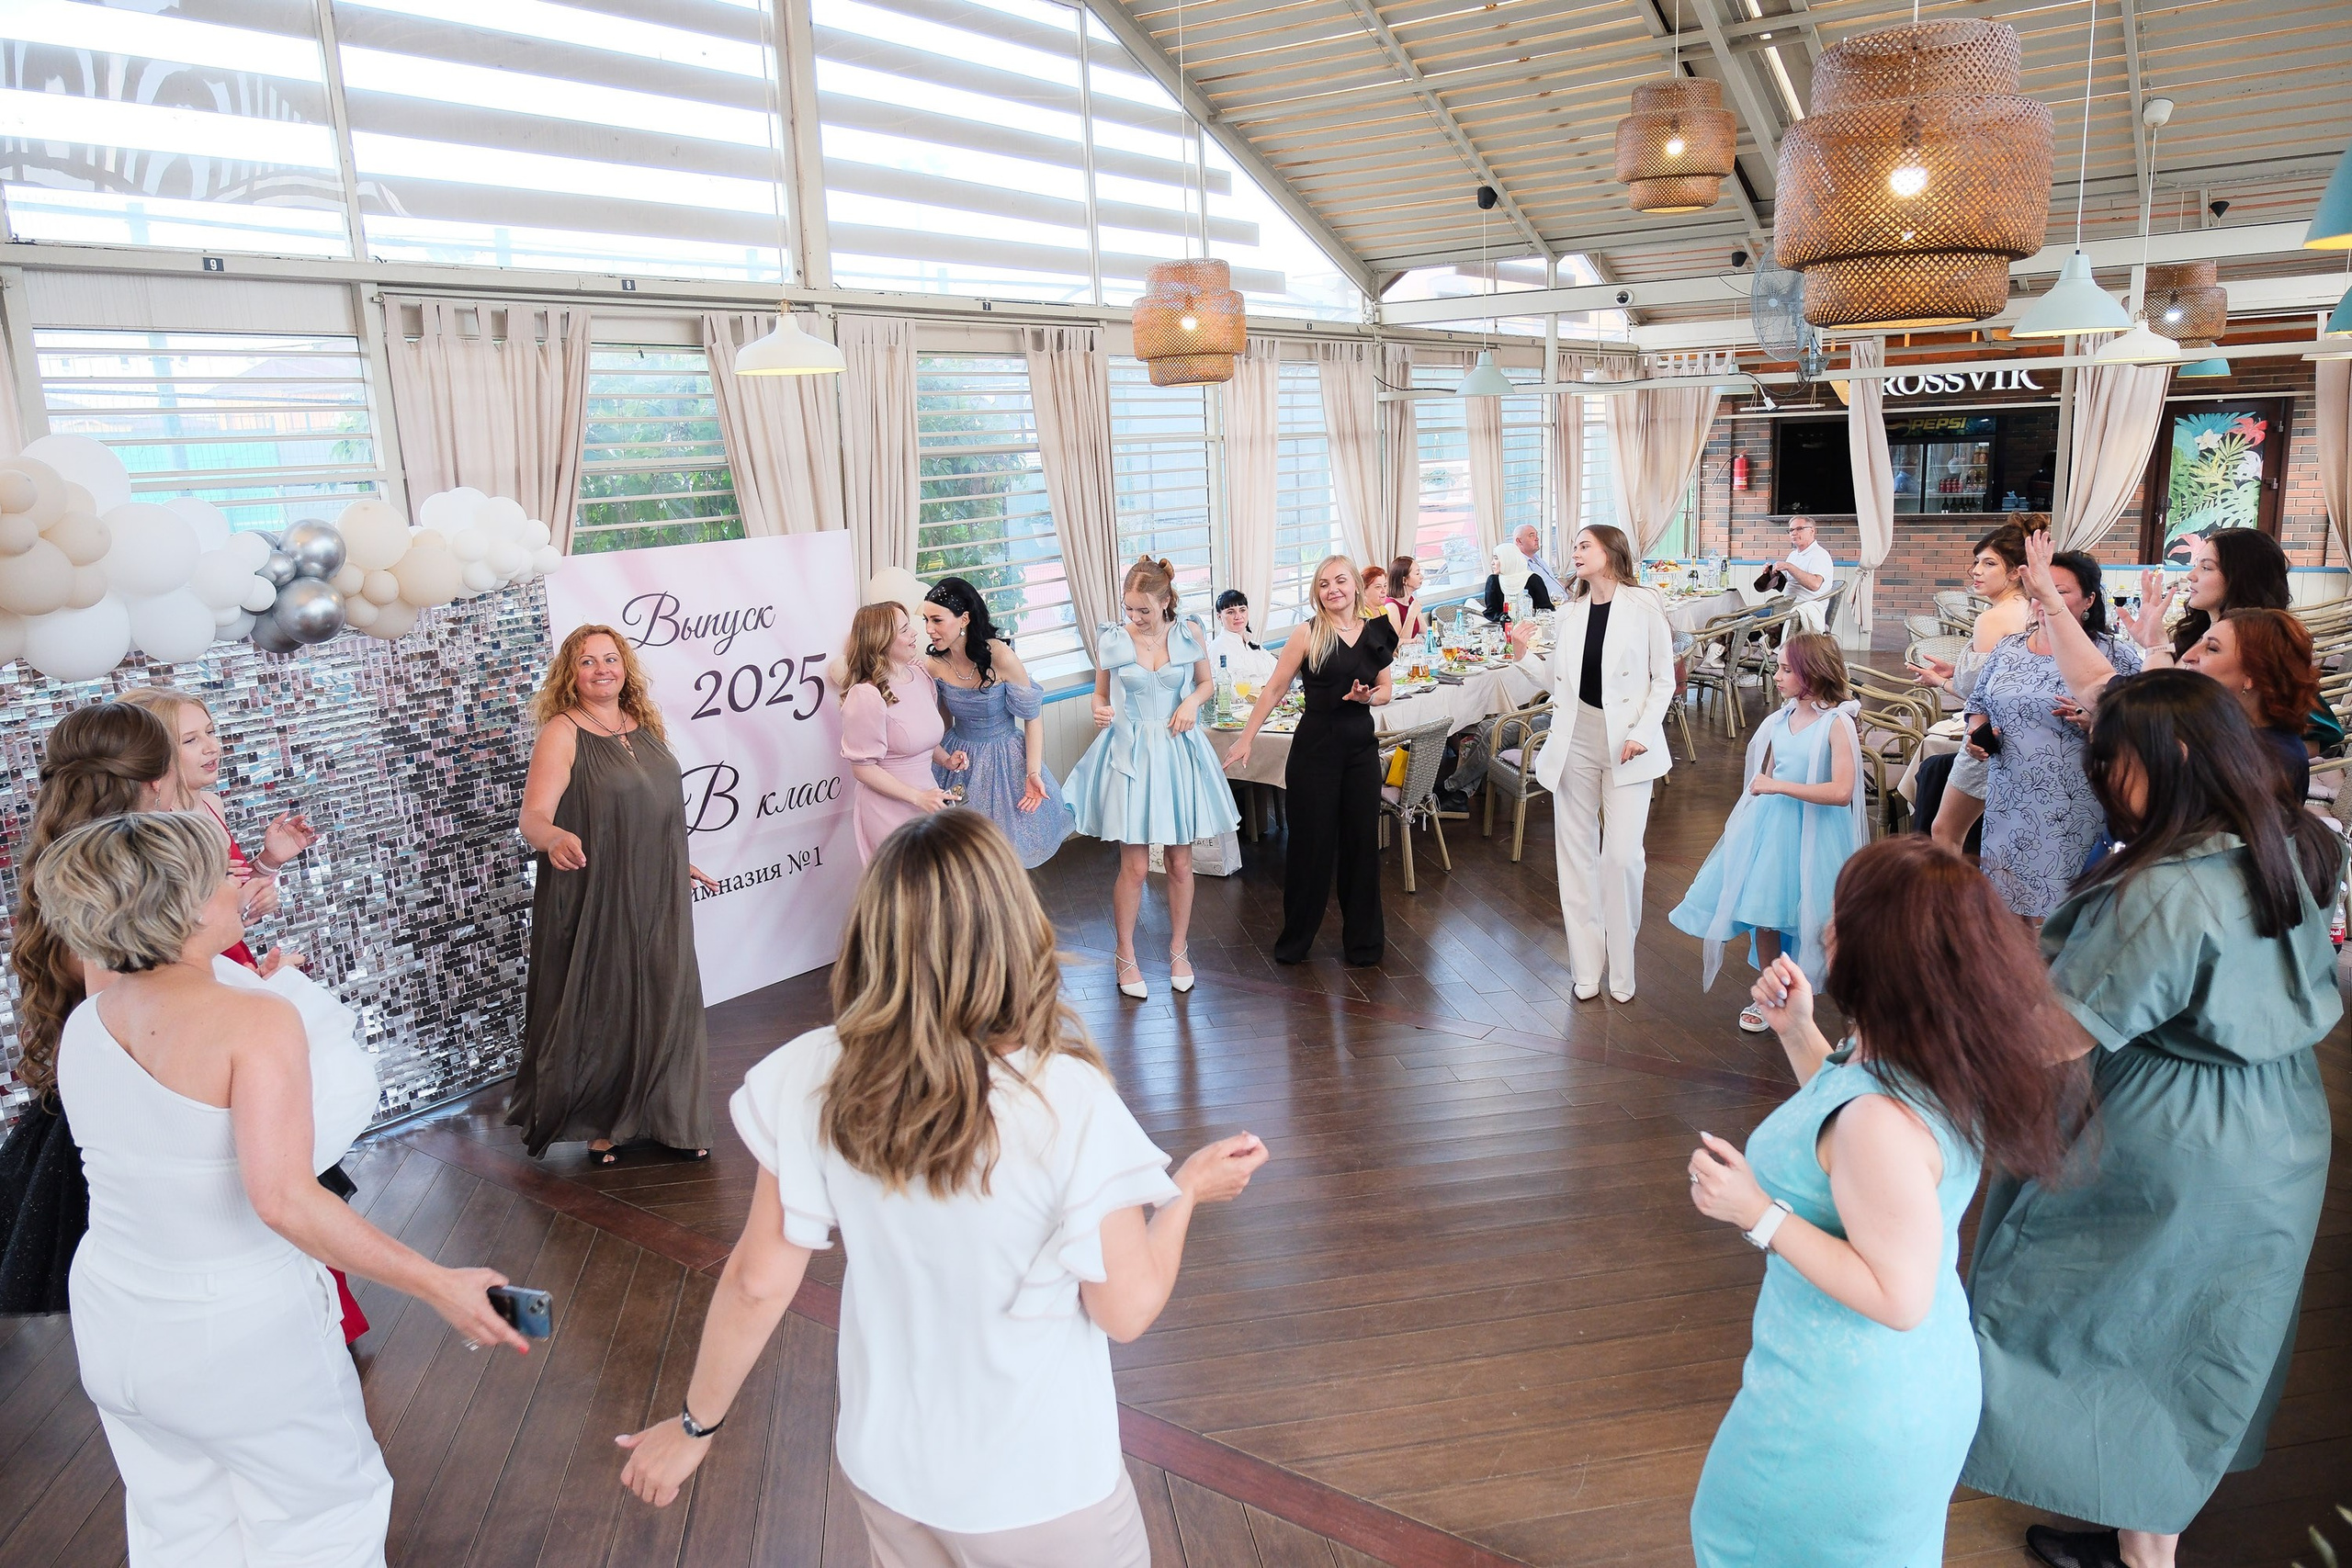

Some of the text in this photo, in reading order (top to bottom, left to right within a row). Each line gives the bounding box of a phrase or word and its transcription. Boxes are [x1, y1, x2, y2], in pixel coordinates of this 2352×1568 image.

[209, 258, 218, 271] 9
[626, 280, 632, 290] 8
[1911, 417, 1967, 431] PEPSI
[622, 591, 776, 656] Выпуск
[691, 652, 827, 721] 2025
[682, 760, 843, 837] В класс
[786, 846, 823, 875] №1
